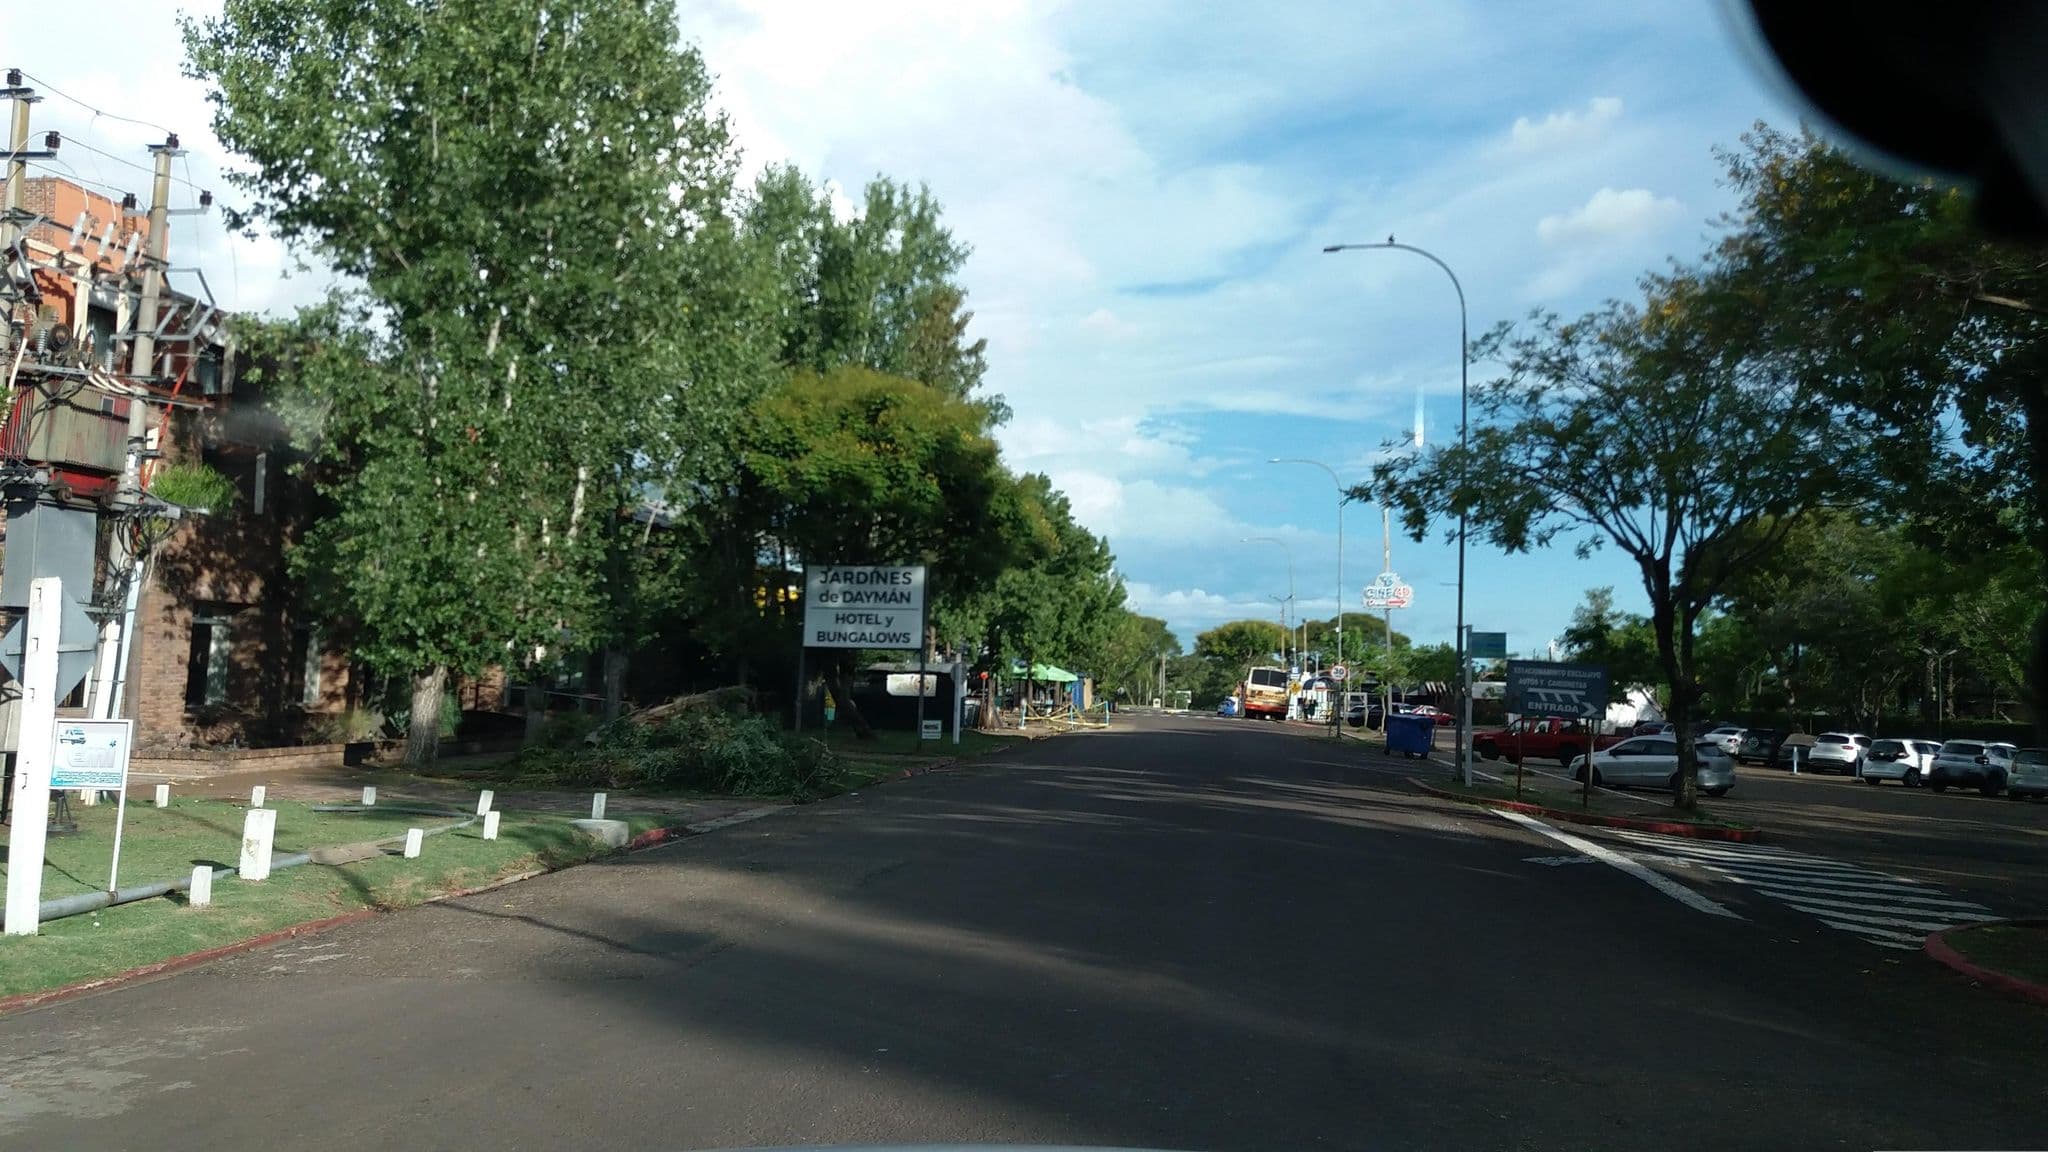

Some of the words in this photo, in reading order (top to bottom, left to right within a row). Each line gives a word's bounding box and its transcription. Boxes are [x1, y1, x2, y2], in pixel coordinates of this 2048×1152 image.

[818, 589, 839, 603] de
[842, 587, 911, 604] DAYMÁN
[835, 613, 882, 625] HOTEL
[884, 615, 895, 628] y
[816, 631, 911, 644] BUNGALOWS
[1333, 667, 1345, 675] 30
[1527, 702, 1579, 713] ENTRADA
